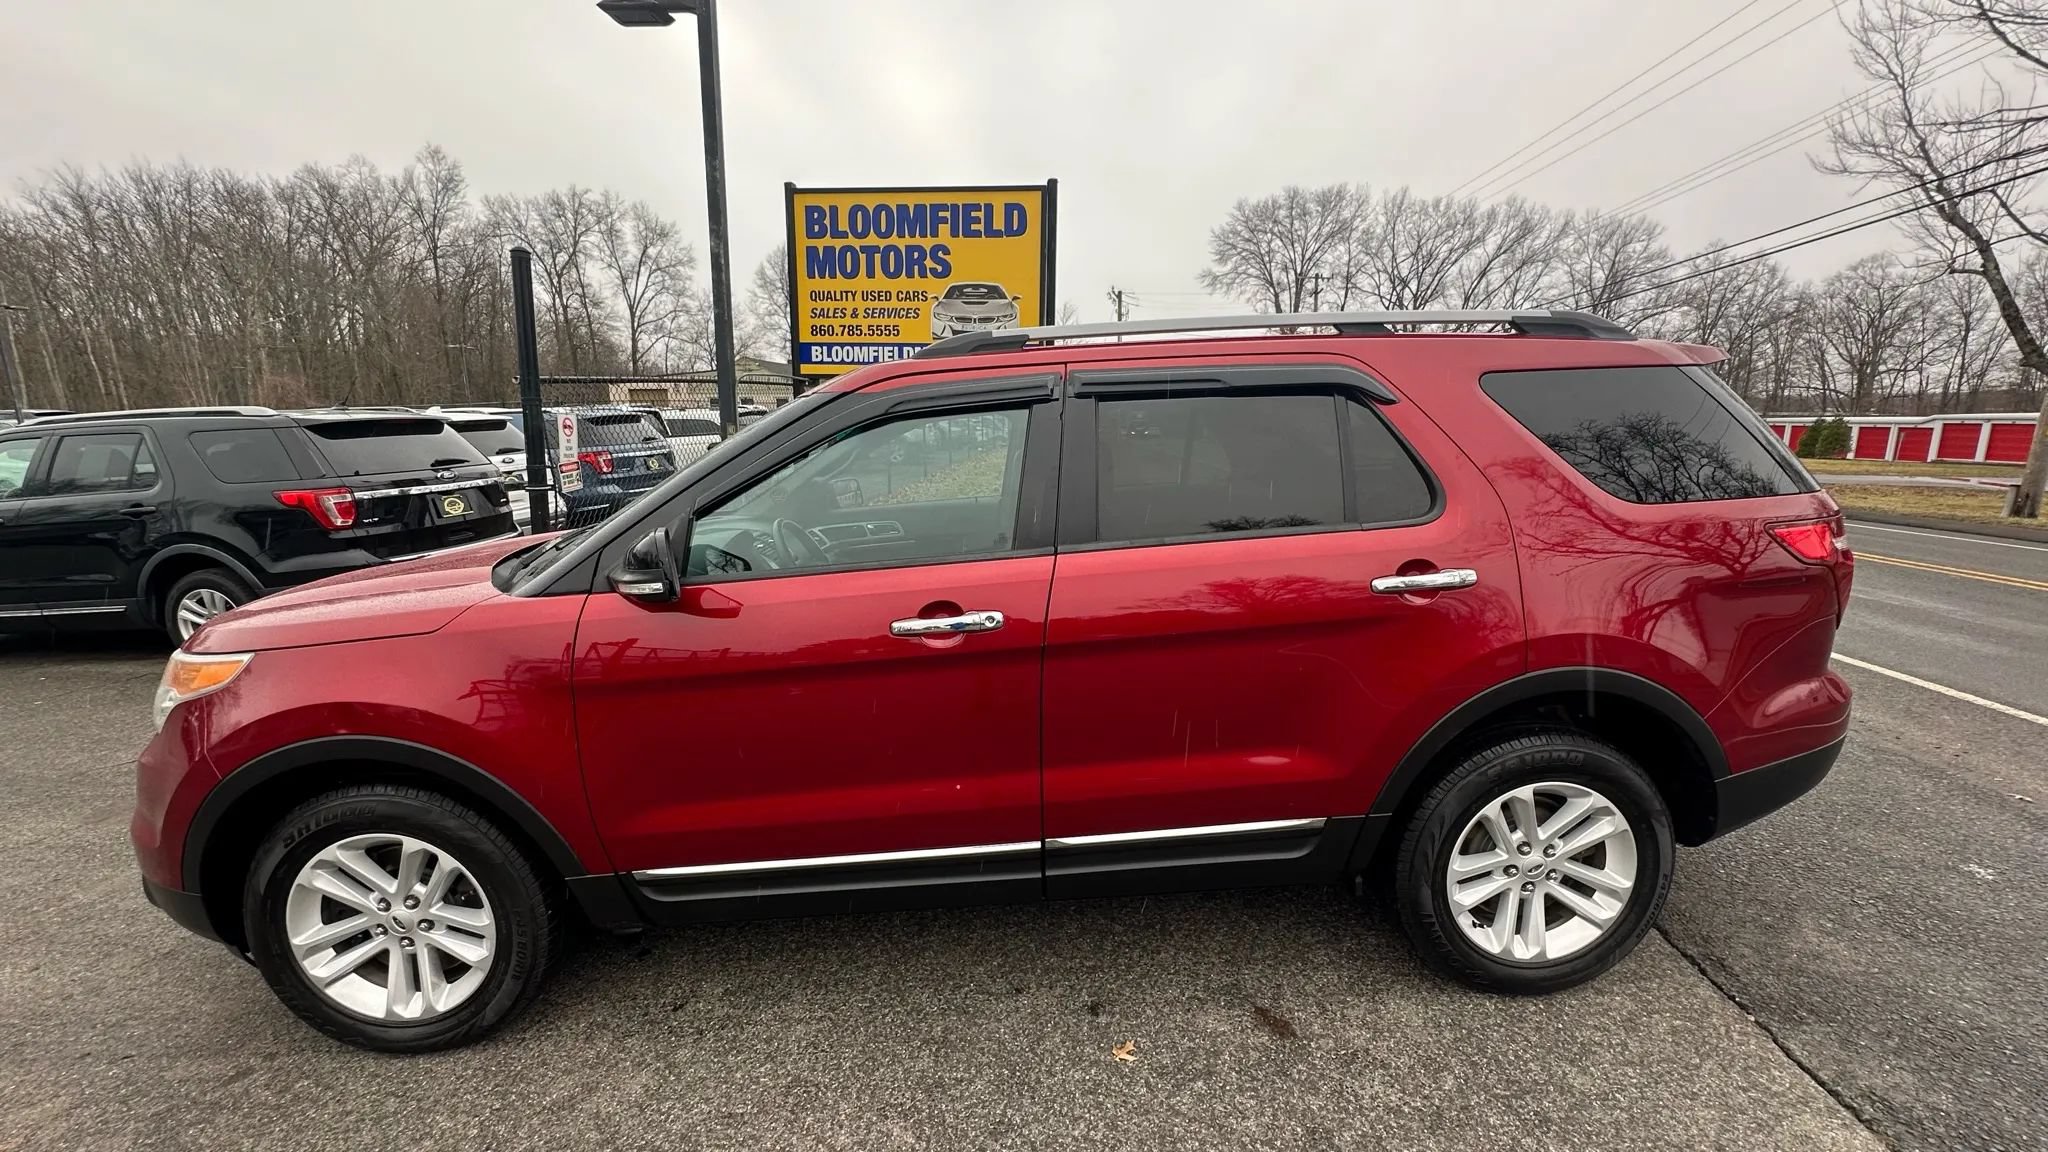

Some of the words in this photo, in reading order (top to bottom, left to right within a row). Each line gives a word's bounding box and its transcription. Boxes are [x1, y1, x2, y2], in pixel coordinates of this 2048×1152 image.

[804, 203, 1028, 239] BLOOMFIELD
[806, 244, 952, 279] MOTORS
[810, 290, 857, 303] QUALITY
[861, 290, 892, 302] USED
[896, 290, 928, 302] CARS
[810, 308, 847, 319] SALES
[850, 308, 859, 319] &
[863, 307, 920, 320] SERVICES
[810, 324, 900, 337] 860.785.5555
